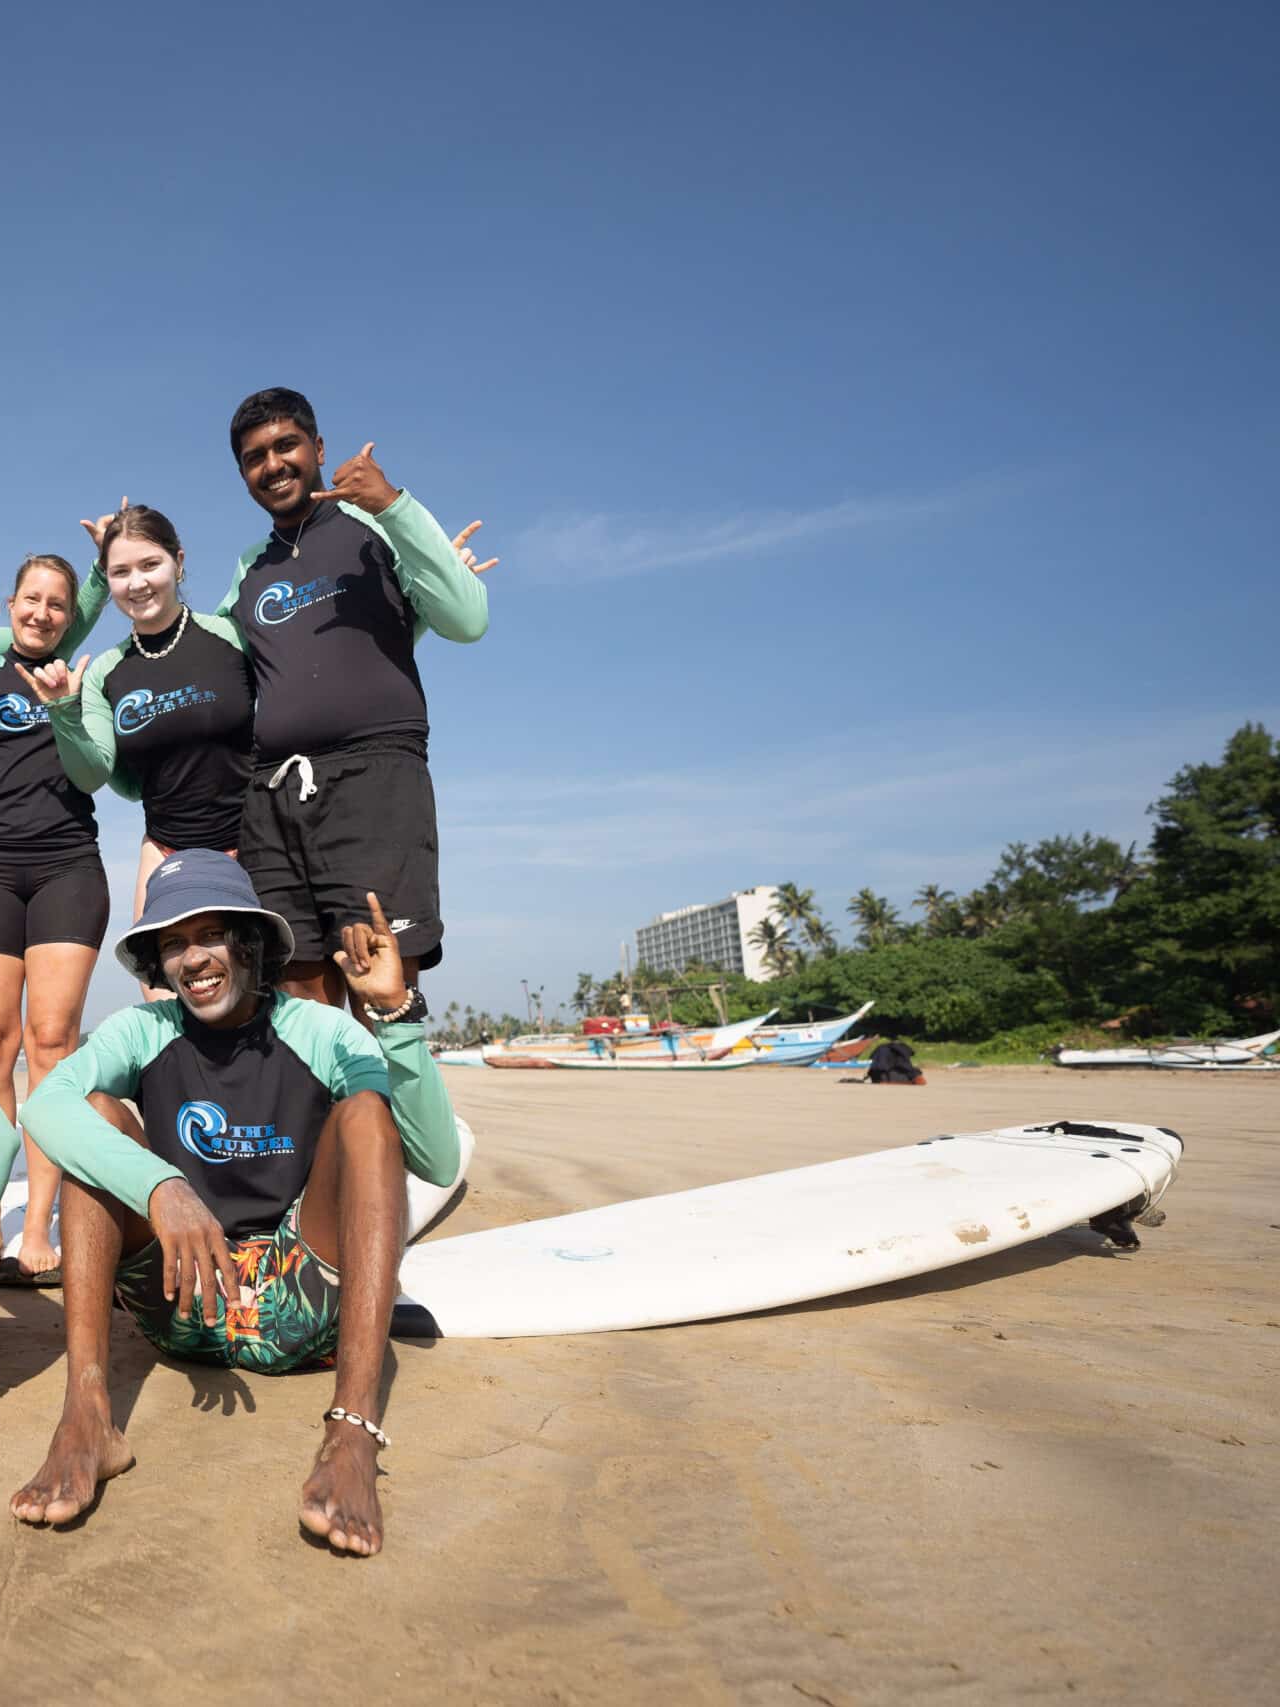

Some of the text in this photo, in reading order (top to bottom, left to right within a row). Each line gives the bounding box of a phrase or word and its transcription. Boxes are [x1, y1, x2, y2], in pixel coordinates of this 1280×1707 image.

[138, 690, 217, 715] SURFER
[229, 1124, 275, 1138] THE
[211, 1137, 296, 1152] SURFER
